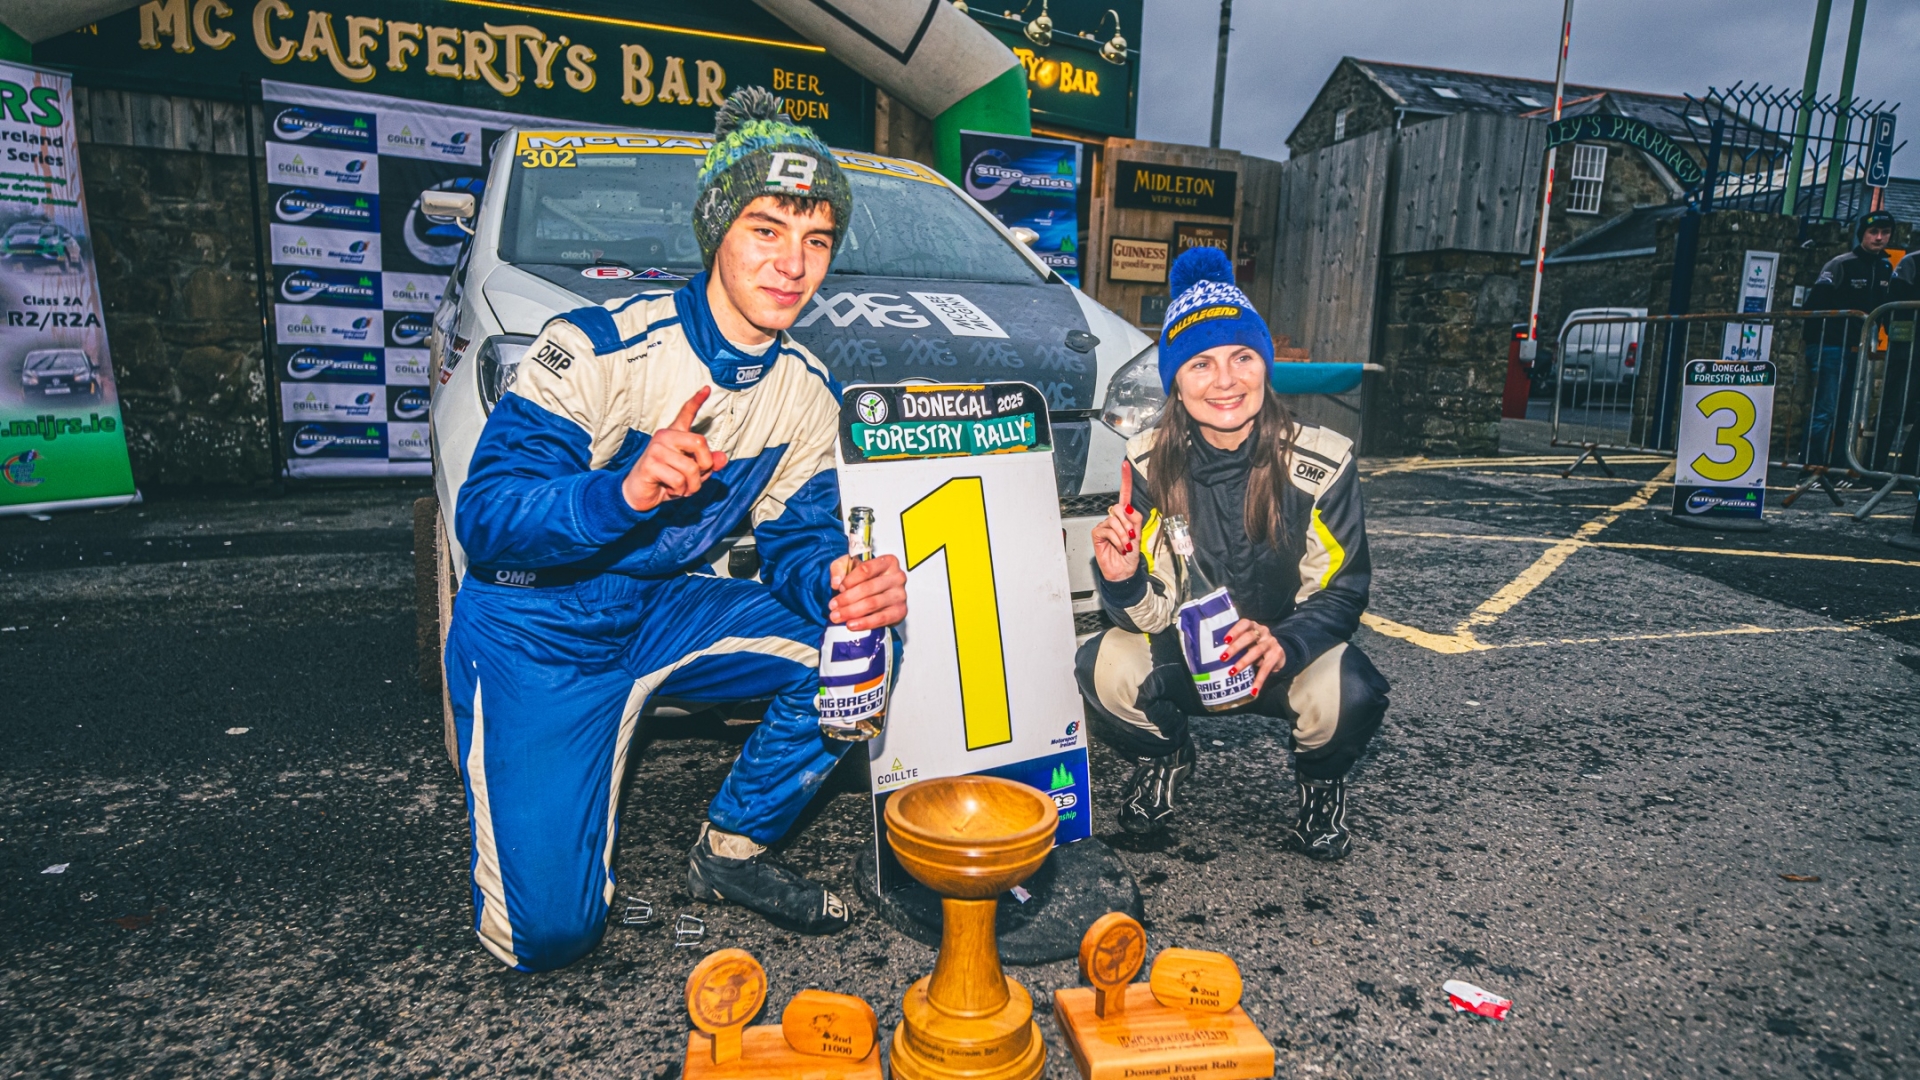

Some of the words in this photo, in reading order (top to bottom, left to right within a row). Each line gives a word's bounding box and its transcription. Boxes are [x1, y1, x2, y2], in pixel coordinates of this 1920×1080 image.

[621, 43, 727, 107] BAR
[773, 67, 824, 96] BEER
[1059, 61, 1101, 97] BAR
[779, 97, 829, 122] RDEN
[0, 130, 64, 149] reland
[387, 133, 426, 147] COILLTE
[1880, 121, 1890, 141] P
[7, 148, 64, 167] Series
[521, 149, 577, 168] 302
[1608, 117, 1700, 183] PHARMACY
[976, 166, 1022, 178] Sligo
[1022, 176, 1074, 189] Pallets
[1134, 170, 1215, 197] MIDLETON
[1152, 195, 1173, 204] VERY
[1175, 198, 1198, 207] RARE
[1113, 243, 1166, 260] GUINNESS
[1178, 234, 1228, 250] POWERS
[1042, 256, 1077, 266] llets
[1121, 259, 1139, 269] good
[1138, 261, 1150, 269] for
[1151, 263, 1165, 271] you
[22, 295, 59, 306] Class
[63, 296, 83, 306] 2A
[392, 290, 430, 300] COILLTE
[7, 310, 101, 332] R2/R2A
[537, 345, 571, 371] OMP
[395, 365, 430, 374] COILLT
[735, 366, 762, 380] OMP
[1712, 363, 1750, 374] DONEGAL
[1694, 374, 1736, 384] FORESTRY
[1739, 373, 1766, 384] RALLY
[902, 392, 992, 419] DONEGAL
[997, 392, 1024, 413] 2025
[863, 423, 962, 453] FORESTRY
[973, 417, 1027, 449] RALLY
[1690, 389, 1758, 482] 3
[1296, 463, 1326, 481] OMP
[496, 570, 536, 585] OMP
[900, 475, 1014, 752] 1
[837, 685, 884, 708] BREEN
[877, 767, 919, 785] COILLTE
[1187, 996, 1220, 1007] J1000
[1200, 988, 1220, 998] 2nd
[831, 1031, 852, 1045] 2nd
[1124, 1065, 1171, 1079] Donegal
[1174, 1062, 1208, 1074] Forest
[1211, 1060, 1239, 1071] Rally
